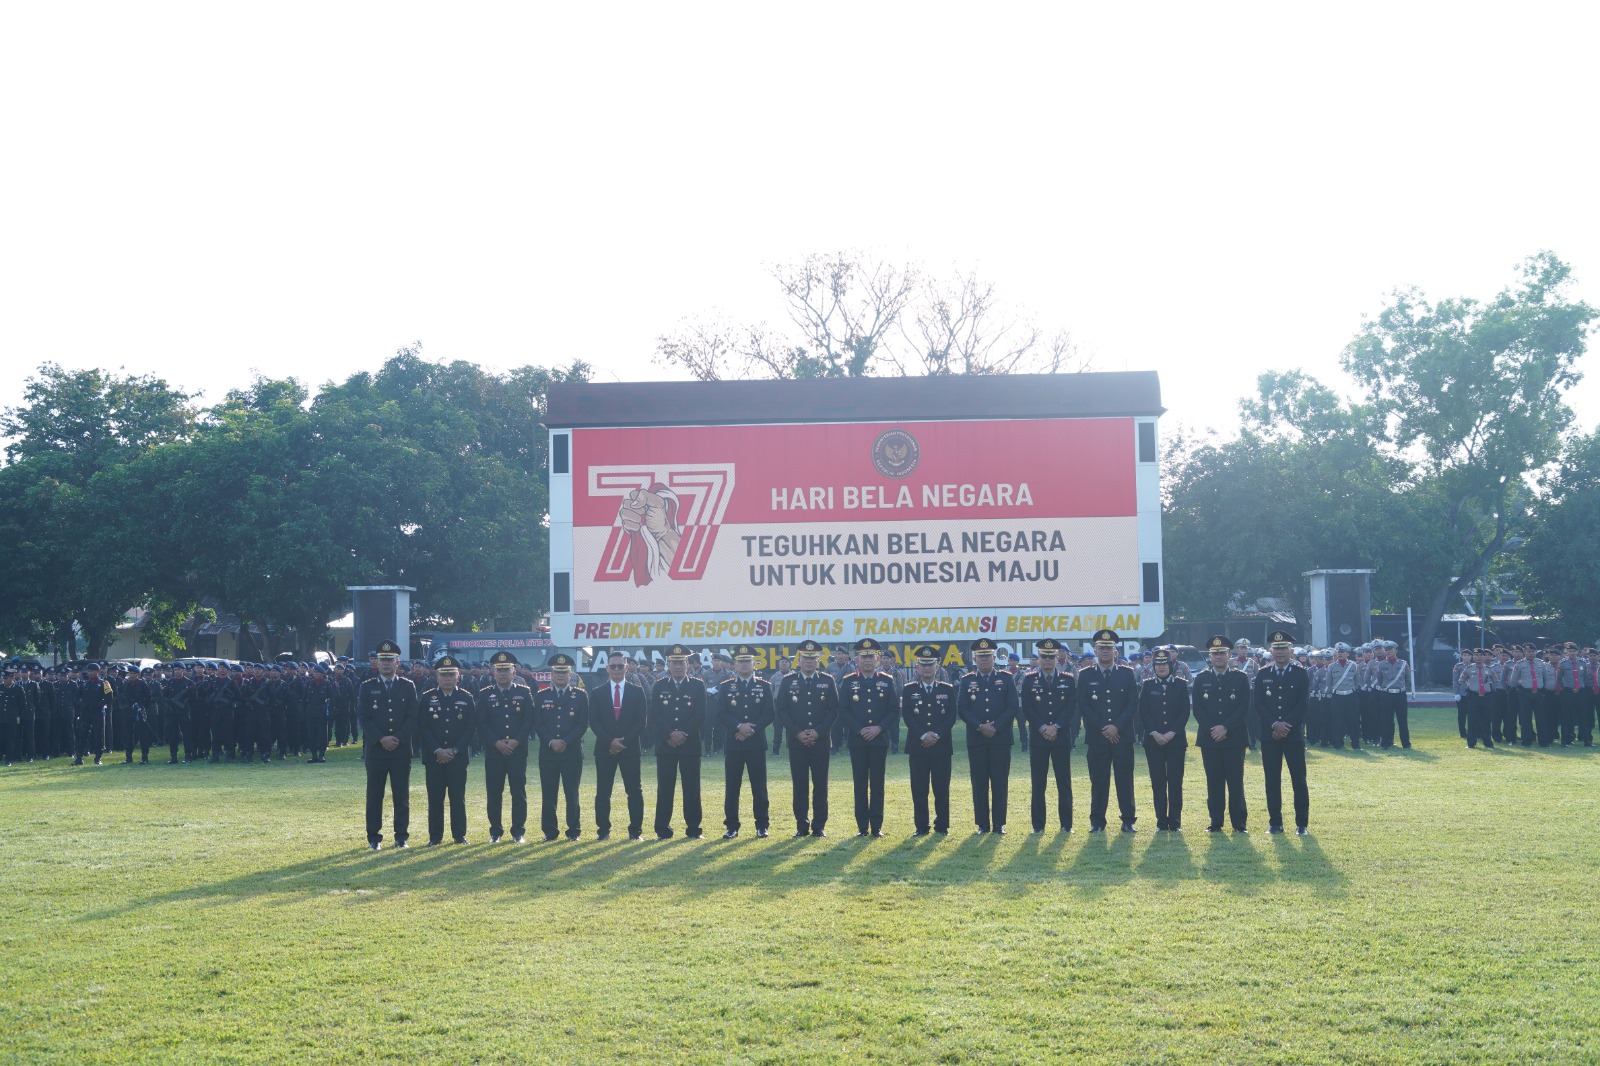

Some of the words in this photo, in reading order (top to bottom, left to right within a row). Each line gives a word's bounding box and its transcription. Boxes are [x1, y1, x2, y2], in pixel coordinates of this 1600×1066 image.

[771, 486, 834, 511] HARI
[843, 485, 914, 509] BELA
[922, 482, 1034, 507] NEGARA
[588, 463, 736, 583] 77
[741, 533, 880, 557] TEGUHKAN
[887, 531, 954, 555] BELA
[961, 530, 1067, 553] NEGARA
[750, 563, 836, 587] UNTUK
[843, 560, 981, 585] INDONESIA
[988, 559, 1060, 582] MAJU
[573, 621, 673, 640] PREDIKTIF
[680, 619, 844, 639] RESPONSIBILITAS
[853, 615, 998, 635] TRANSPARANSI
[1005, 613, 1141, 633] BERKEADILAN
[497, 639, 524, 648] POLDA
[525, 638, 544, 647] NTB
